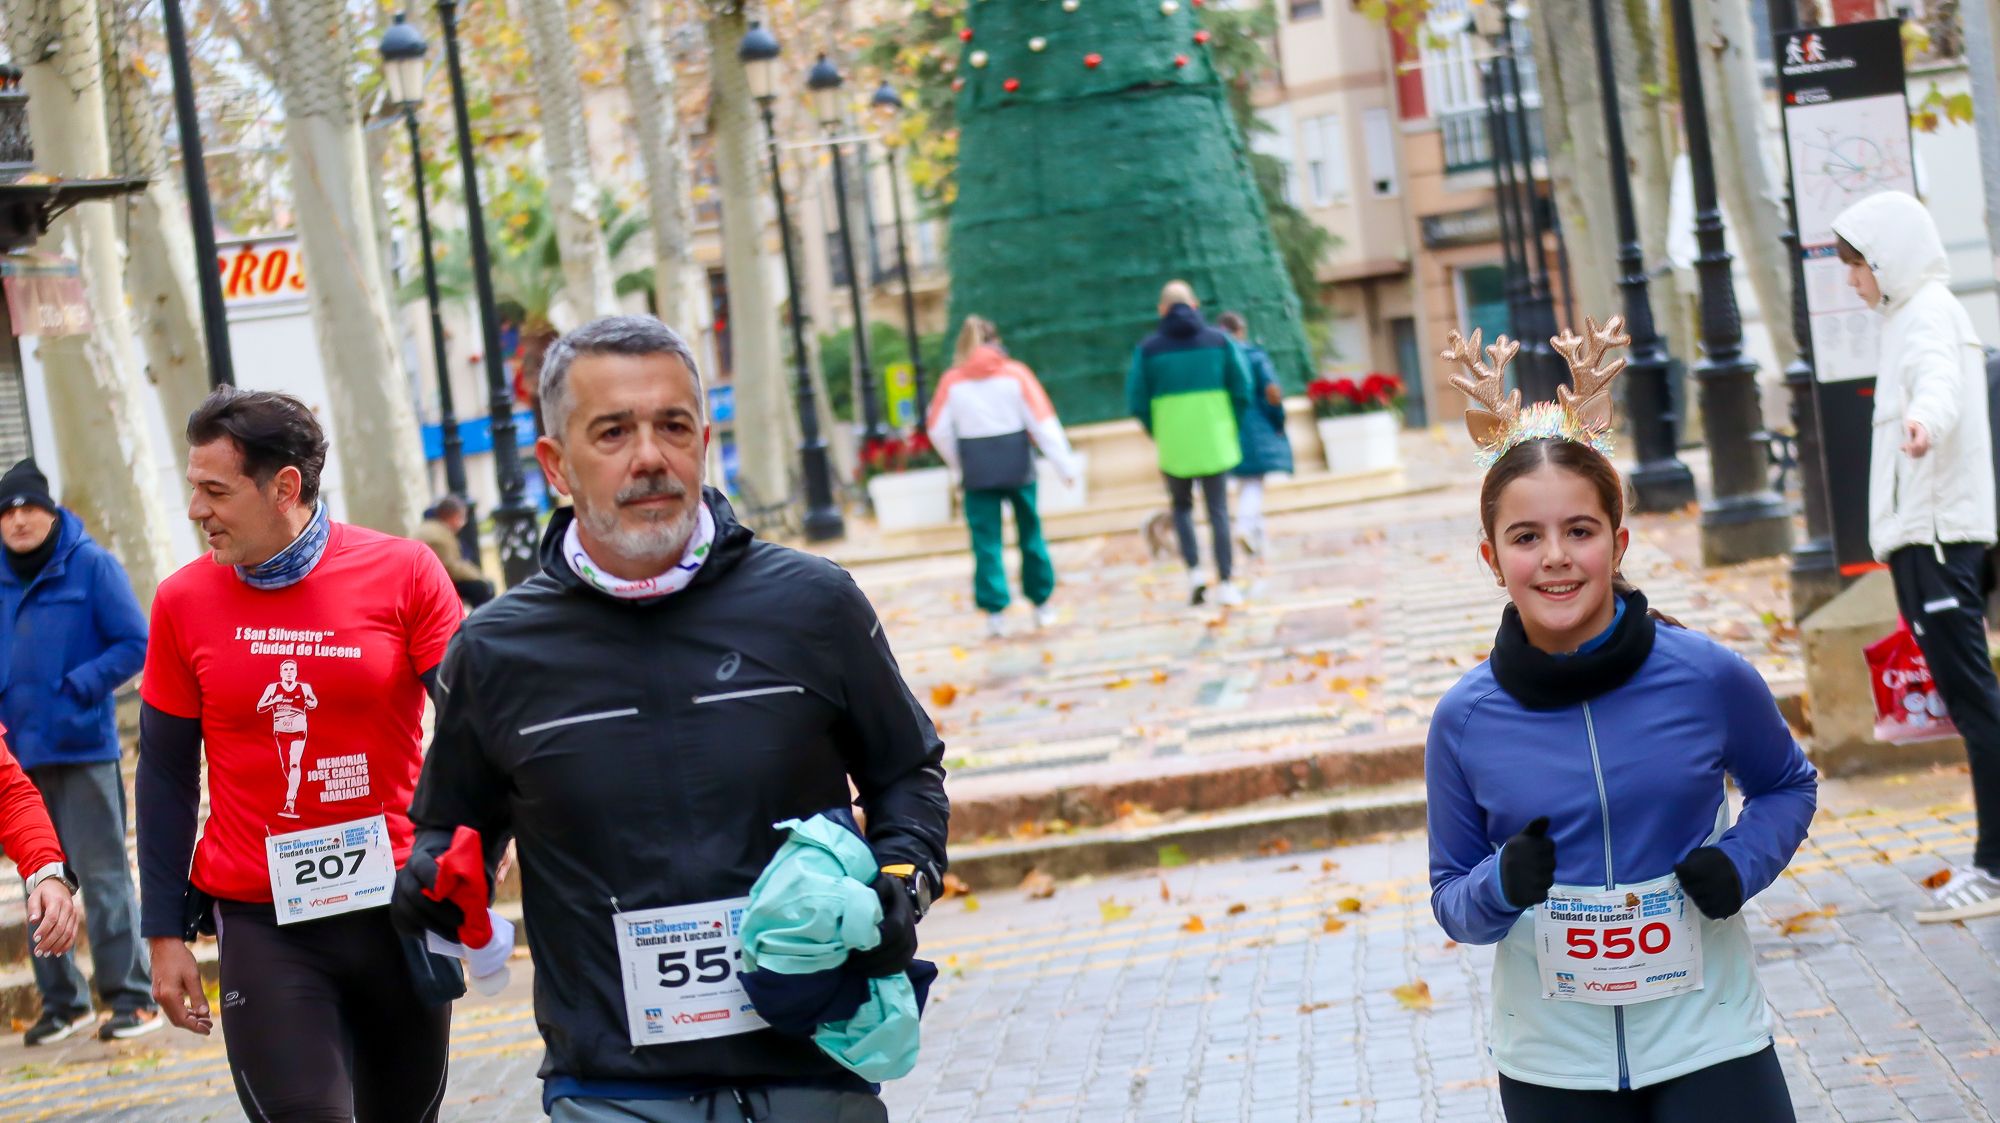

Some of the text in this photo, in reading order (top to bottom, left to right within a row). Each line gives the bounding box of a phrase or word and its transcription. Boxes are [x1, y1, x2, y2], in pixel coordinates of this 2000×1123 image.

[235, 627, 242, 640] I
[244, 628, 266, 640] San
[268, 627, 323, 642] Silvestre
[250, 641, 361, 658] Ciudad de Lucena
[317, 752, 368, 770] MEMORIAL
[307, 764, 369, 782] JOSE CARLOS
[325, 775, 370, 791] HURTADO
[320, 785, 370, 803] MARJALIZO
[280, 849, 304, 859] Ciudad
[315, 844, 340, 853] Lucena
[293, 839, 324, 850] Silvestre
[295, 849, 366, 885] 207
[354, 885, 385, 896] enerplus
[1551, 901, 1568, 911] San
[1570, 902, 1613, 913] Silvestre
[1550, 911, 1634, 923] Ciudad de Lucena
[669, 934, 681, 943] de
[1566, 922, 1671, 960] 550
[1646, 969, 1687, 983] enerplus
